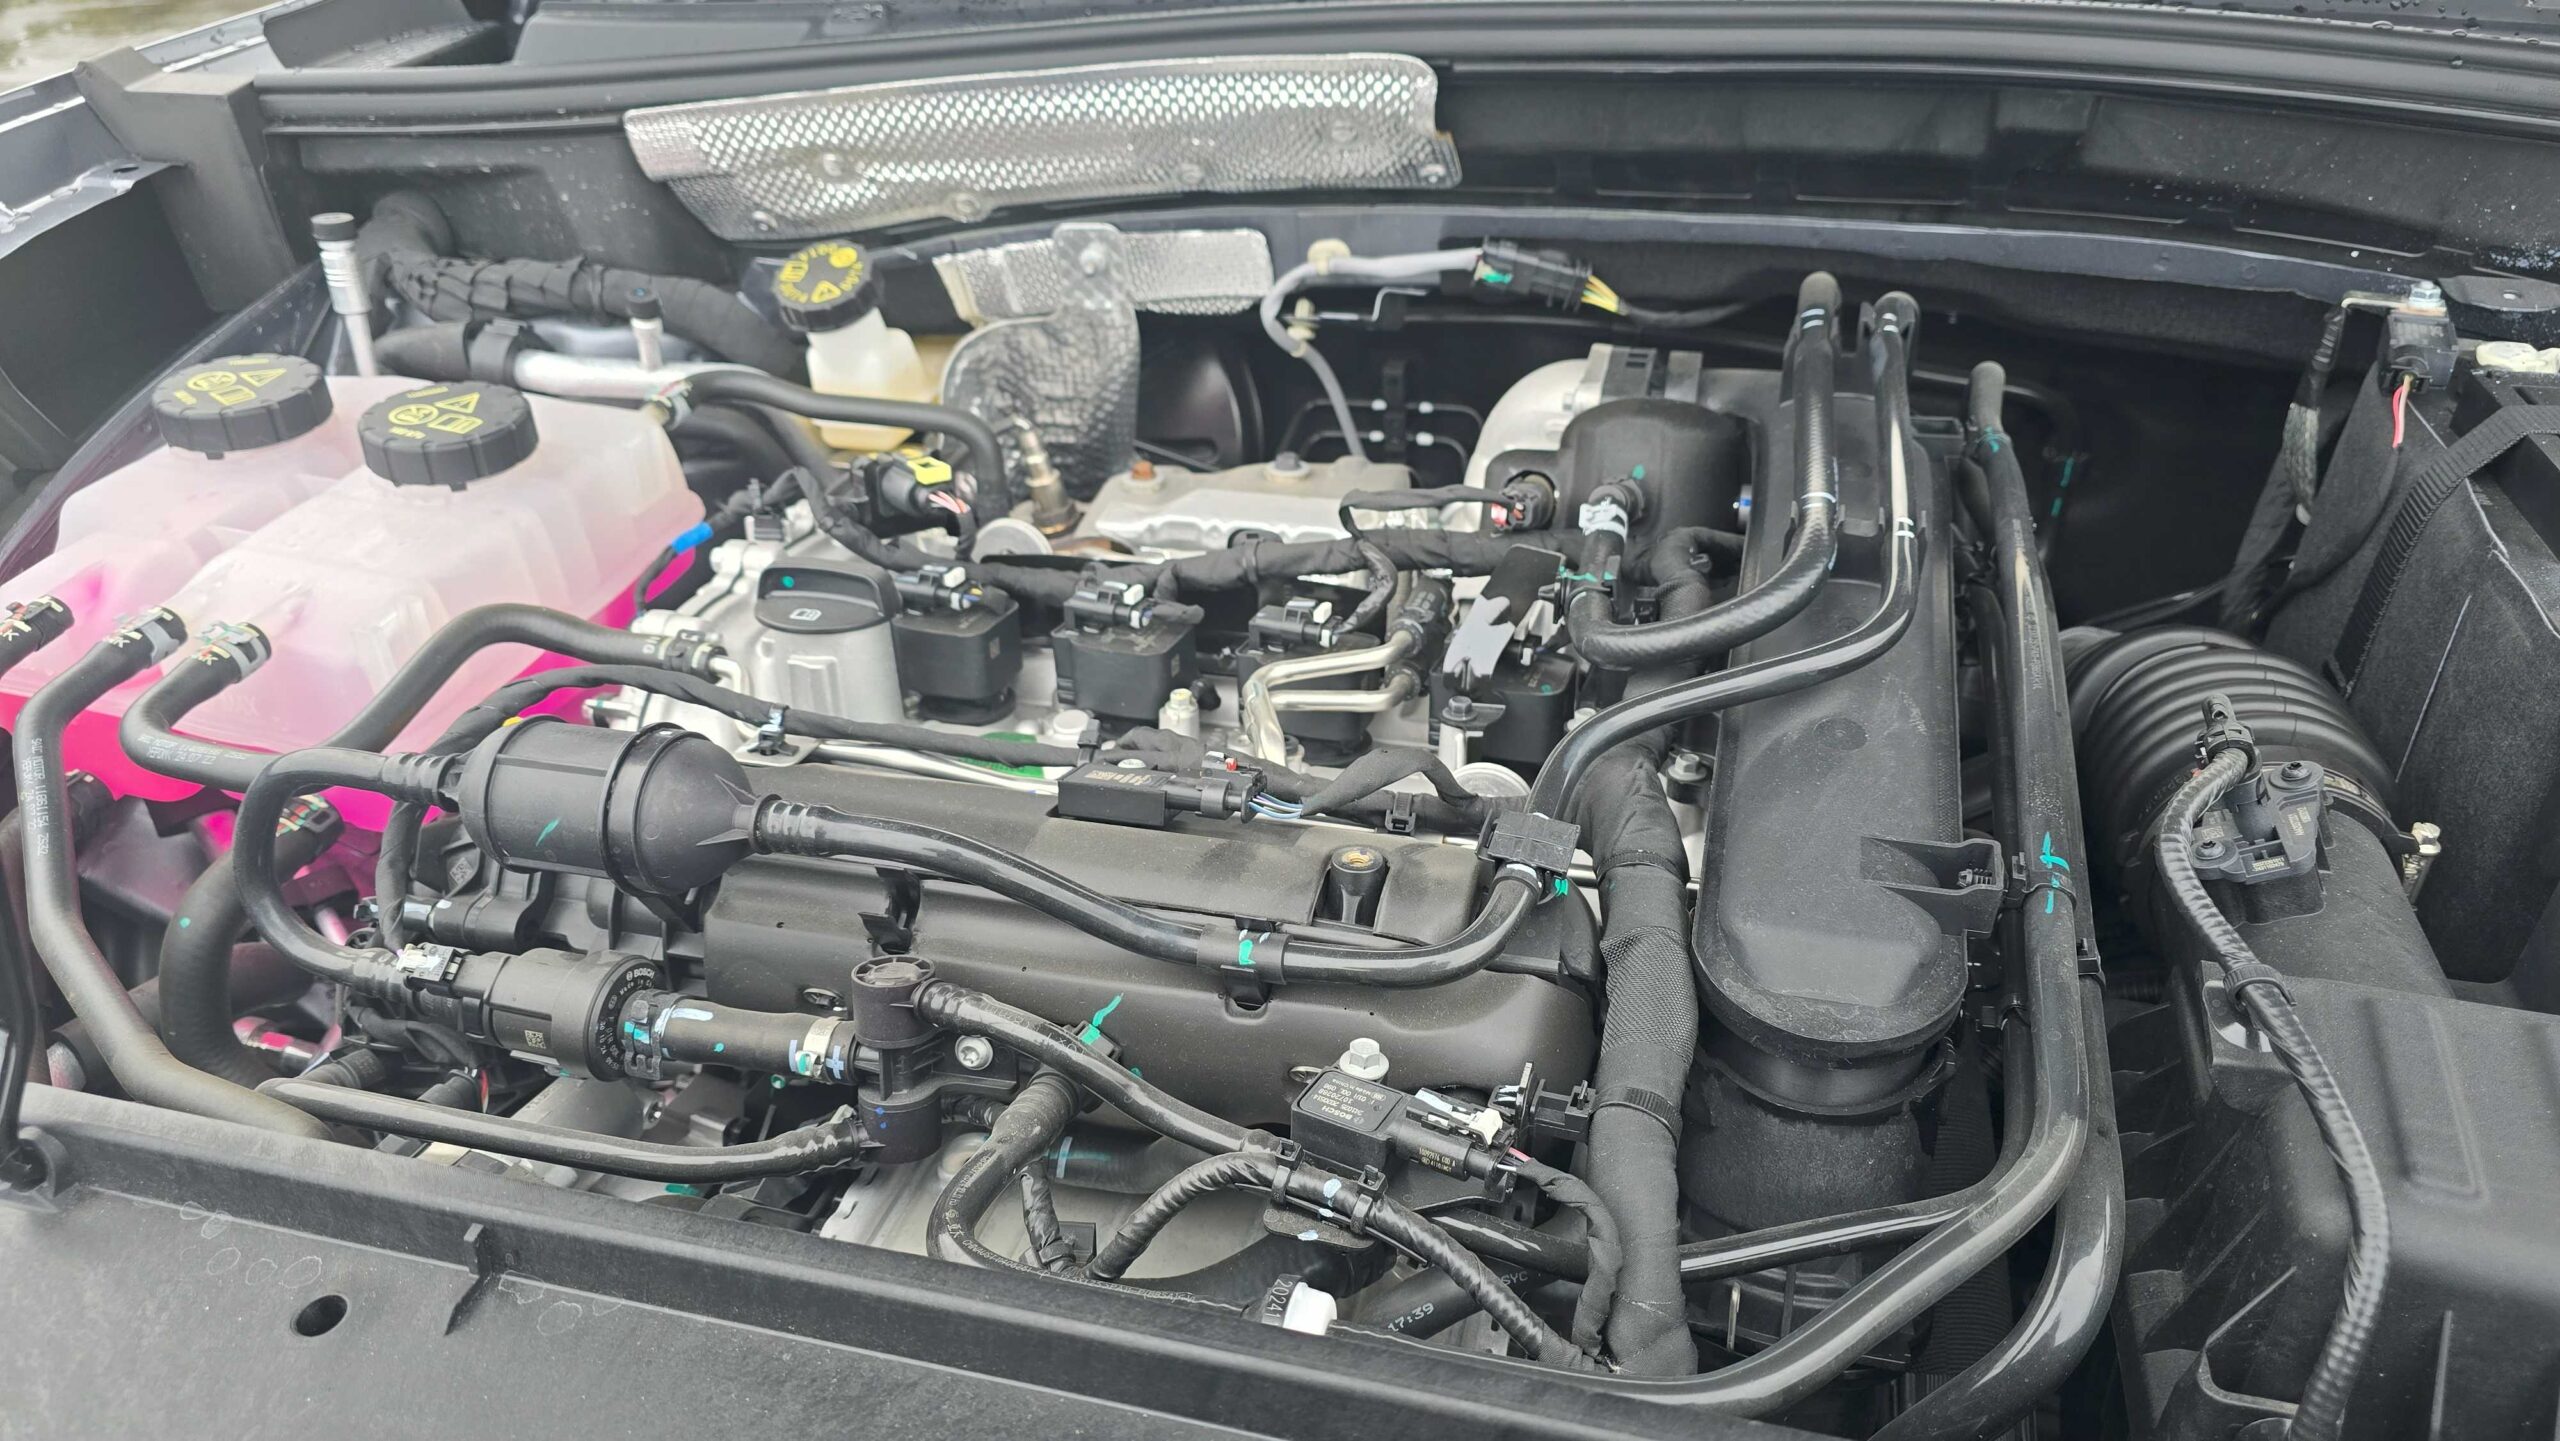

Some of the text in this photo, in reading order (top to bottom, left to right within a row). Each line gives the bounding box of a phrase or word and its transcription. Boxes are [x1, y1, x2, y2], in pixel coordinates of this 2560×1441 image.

[633, 967, 655, 979] BOSCH
[1321, 1105, 1353, 1120] BOSCH
[1388, 1302, 1435, 1332] 17:39
